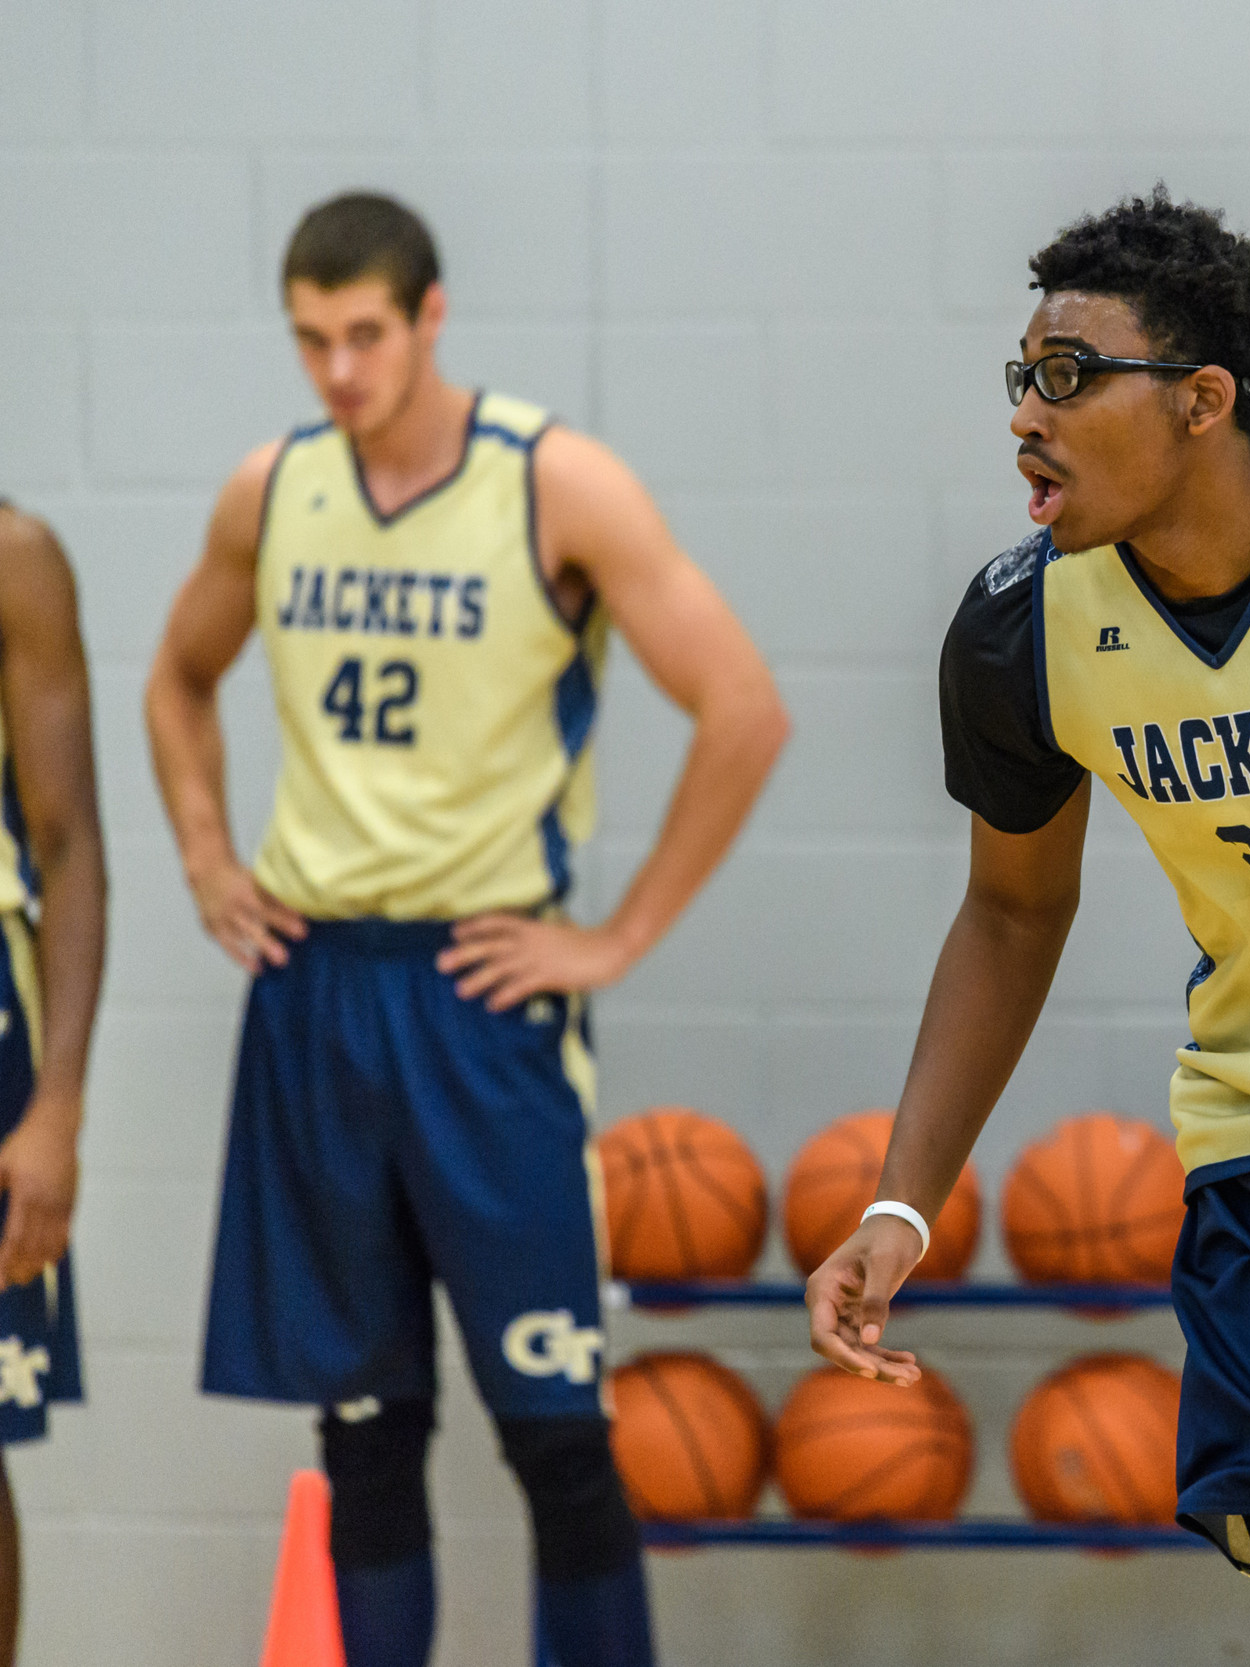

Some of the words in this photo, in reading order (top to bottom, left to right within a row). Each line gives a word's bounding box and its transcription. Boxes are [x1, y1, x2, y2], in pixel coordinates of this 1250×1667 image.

[279, 567, 486, 639] JACKETS
[1096, 643, 1130, 652] RUSSELL
[322, 656, 420, 745] 42
[502, 1308, 604, 1385] GT
